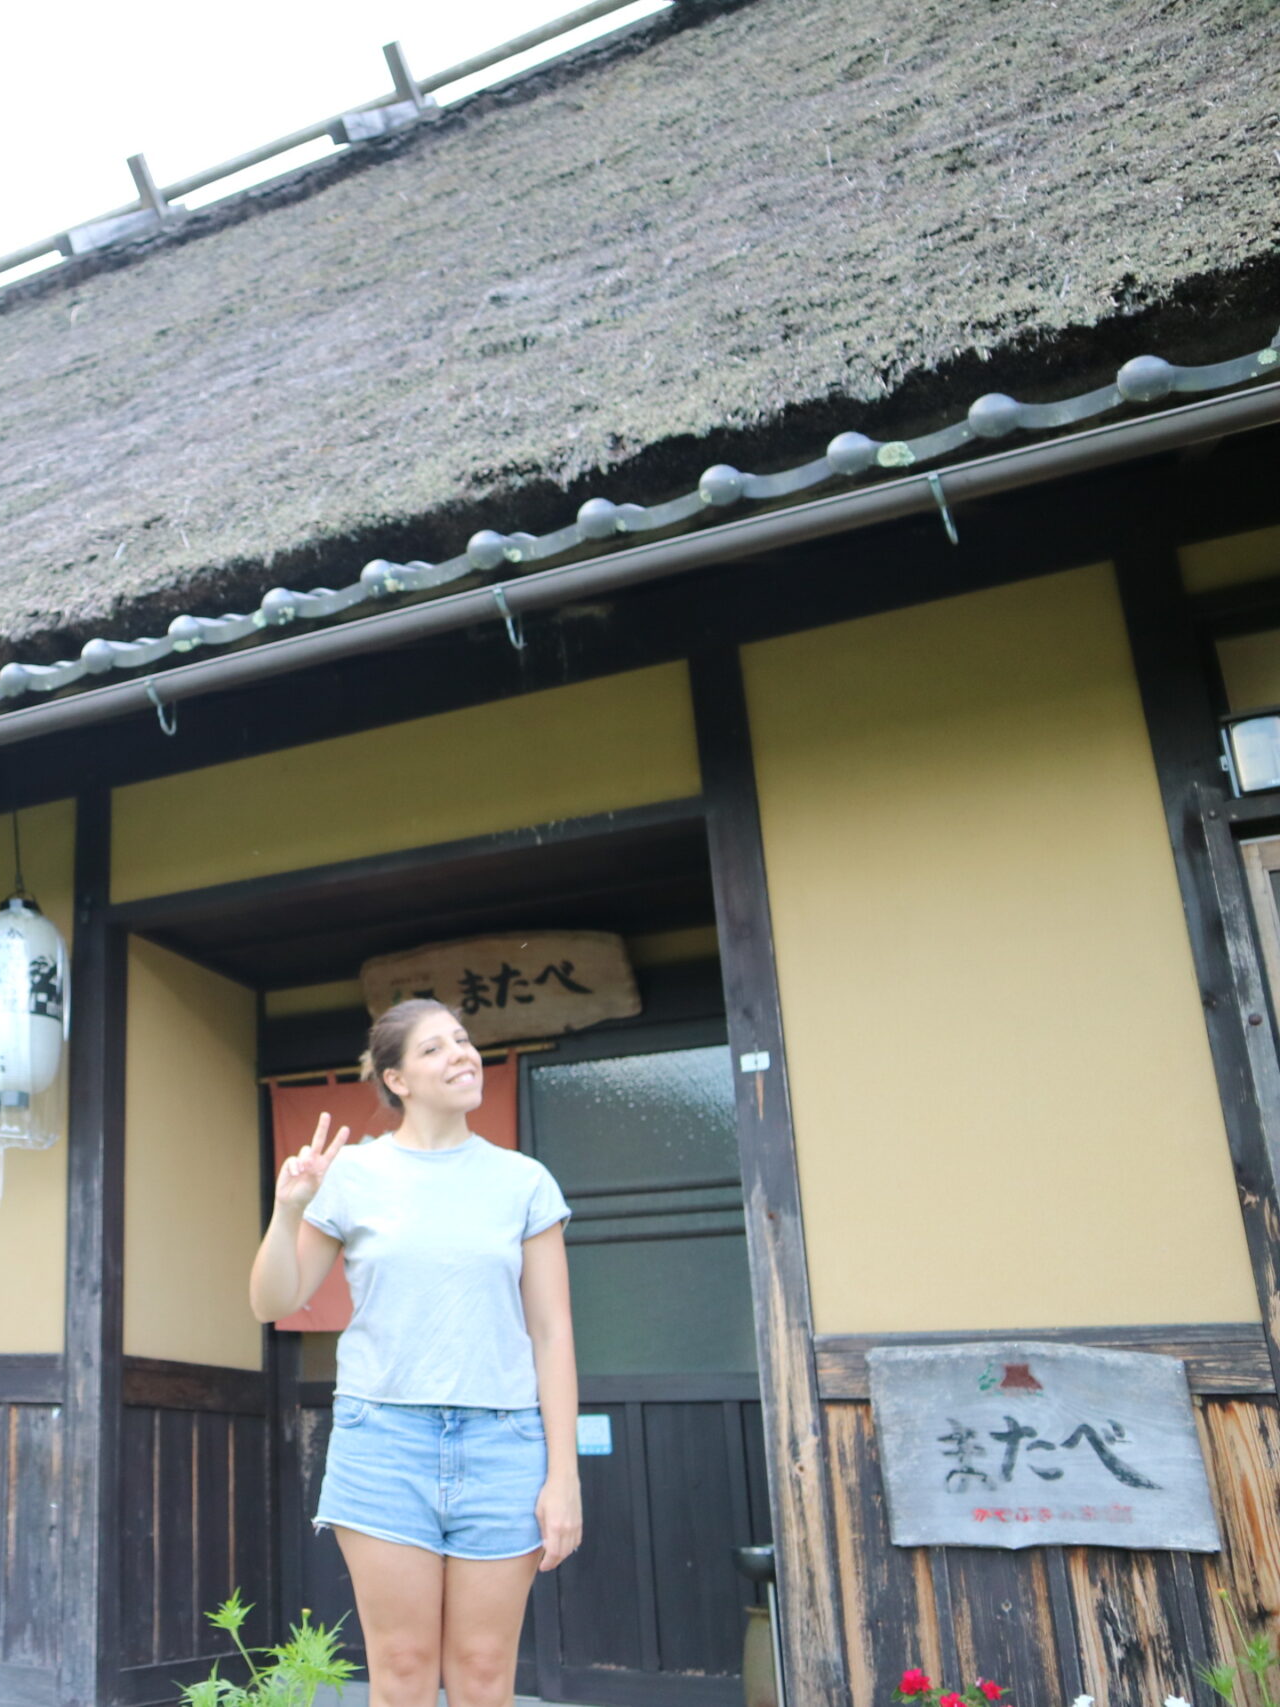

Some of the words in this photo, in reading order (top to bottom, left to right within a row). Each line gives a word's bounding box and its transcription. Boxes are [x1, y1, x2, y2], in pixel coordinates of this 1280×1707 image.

[457, 959, 594, 1015] またべ
[936, 1415, 1164, 1494] またべ
